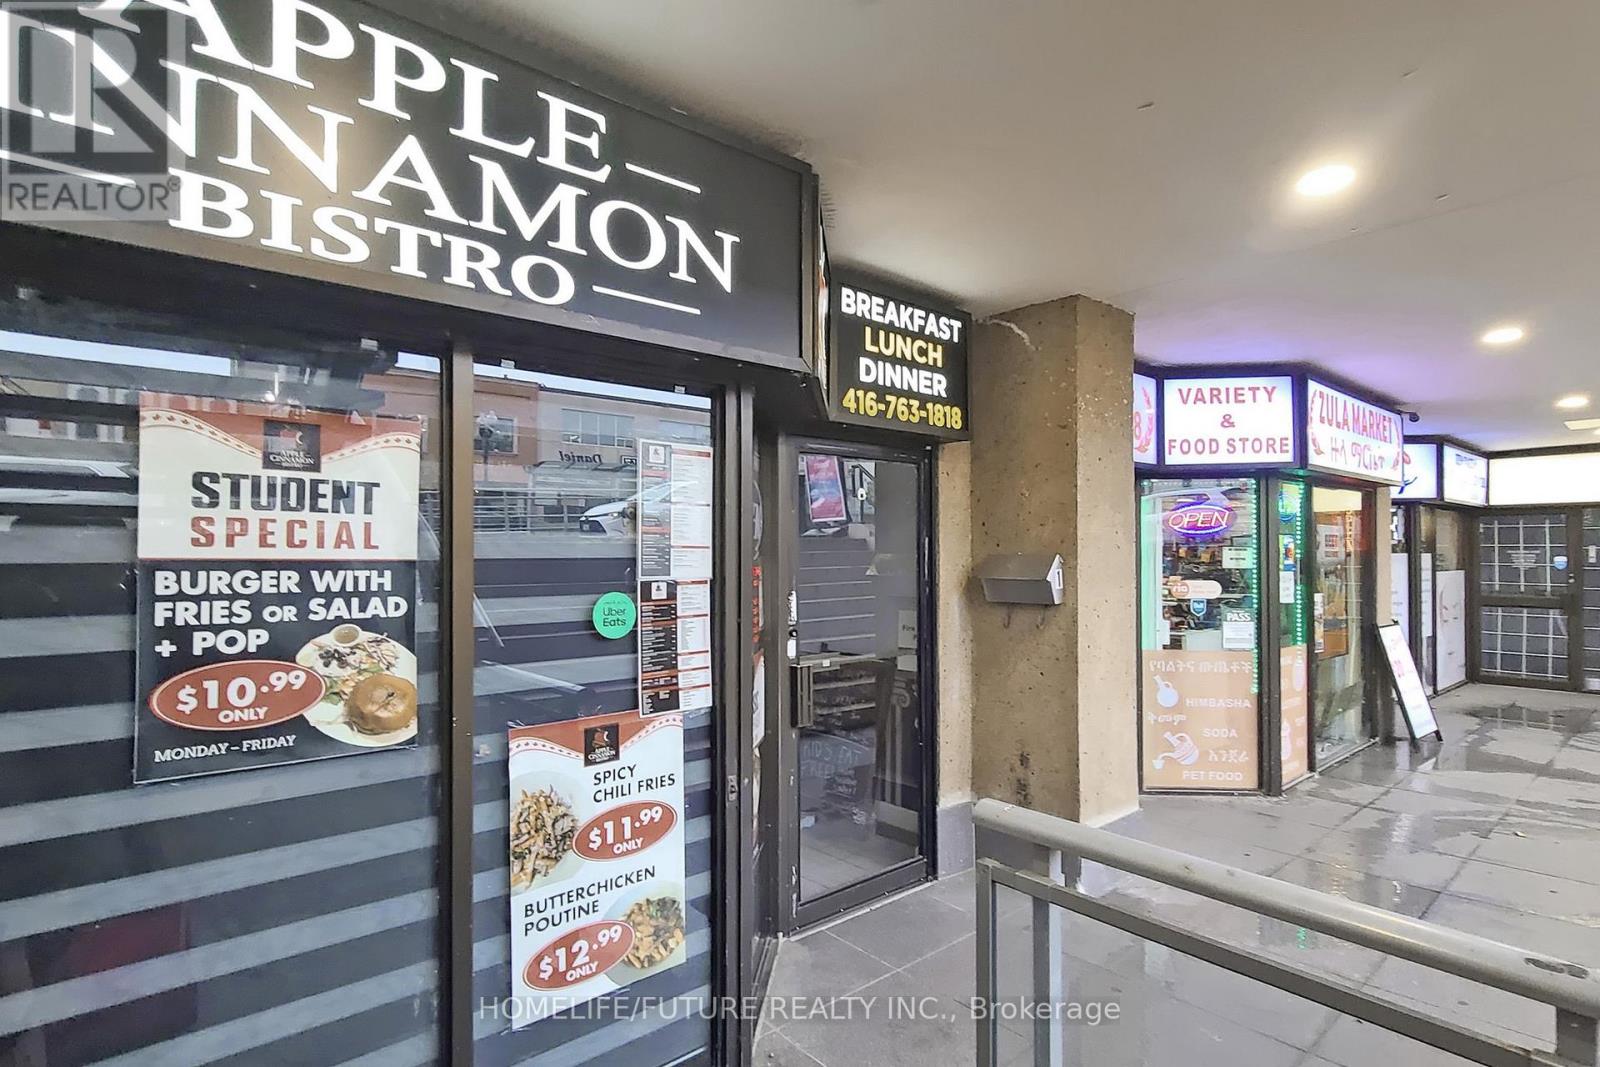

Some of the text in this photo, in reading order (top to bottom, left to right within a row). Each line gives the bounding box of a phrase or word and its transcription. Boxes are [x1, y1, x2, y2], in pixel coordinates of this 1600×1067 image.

[168, 167, 576, 306] BISTRO
[841, 287, 962, 343] BREAKFAST
[864, 326, 943, 368] LUNCH
[859, 357, 947, 398] DINNER
[1177, 386, 1277, 404] VARIETY
[842, 388, 962, 430] 416-763-1818
[1220, 413, 1236, 428] &
[1319, 390, 1392, 444] ZULA MARKET
[1167, 437, 1290, 455] FOOD STORE
[191, 471, 380, 515] STUDENT
[190, 516, 379, 549] SPECIAL
[1169, 511, 1229, 528] OPEN
[154, 569, 392, 596] BURGER WITH
[153, 596, 408, 627] FRIES OR SALAD
[602, 607, 626, 616] Uber
[602, 617, 627, 627] Eats
[1226, 612, 1251, 622] PASS
[192, 629, 270, 656] POP
[175, 669, 307, 715] $10.99
[1185, 698, 1252, 708] HIMBASHA
[218, 706, 268, 723] ONLY
[1202, 728, 1238, 738] SODA
[593, 764, 636, 786] SPICY
[593, 773, 676, 803] CHILI FRIES
[1183, 771, 1243, 780] PET FOOD
[588, 805, 664, 850] $11.99
[613, 837, 644, 855] ONLY
[523, 865, 656, 918] BUTTERCHICKEN
[523, 900, 599, 937] POUTINE
[538, 924, 622, 981] $12.99
[565, 961, 599, 982] ONLY
